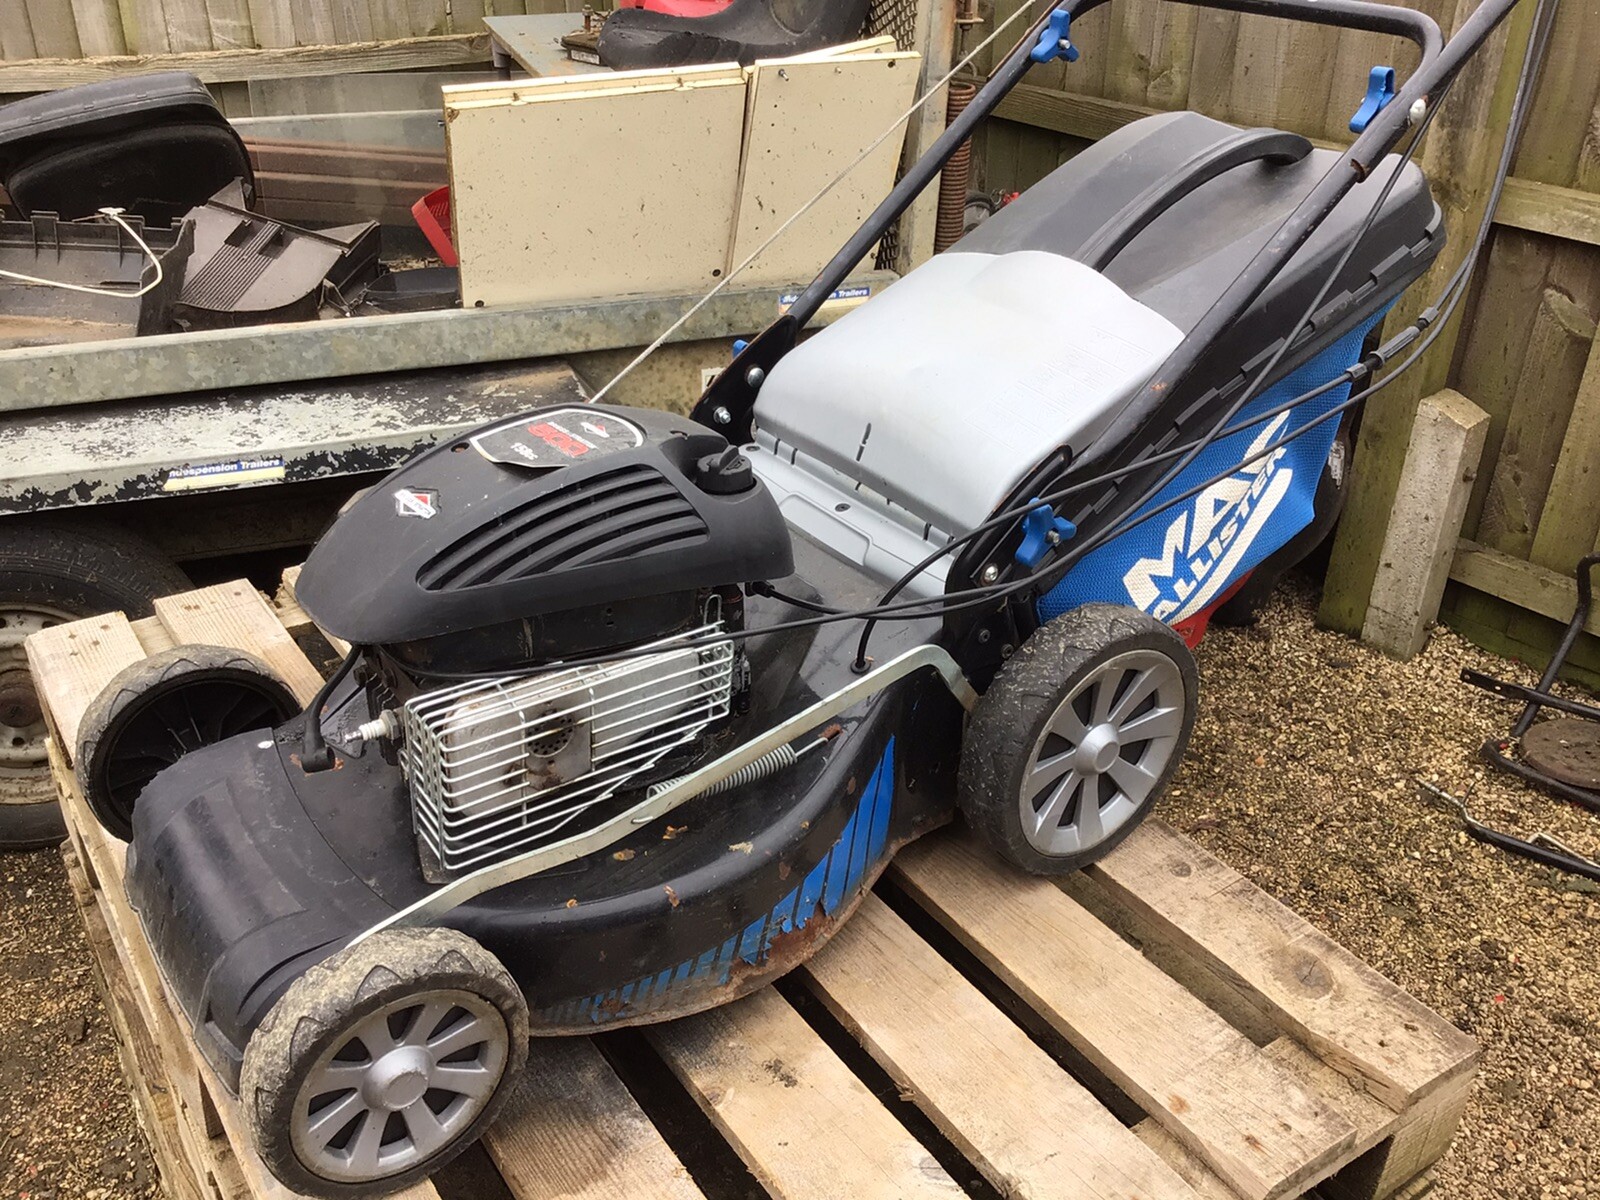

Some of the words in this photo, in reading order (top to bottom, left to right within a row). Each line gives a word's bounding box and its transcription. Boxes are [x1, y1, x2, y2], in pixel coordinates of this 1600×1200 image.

[838, 289, 865, 298] Trailers
[240, 459, 280, 470] Trailers
[1122, 409, 1291, 612] MAC
[1152, 446, 1288, 622] ALLISTER
